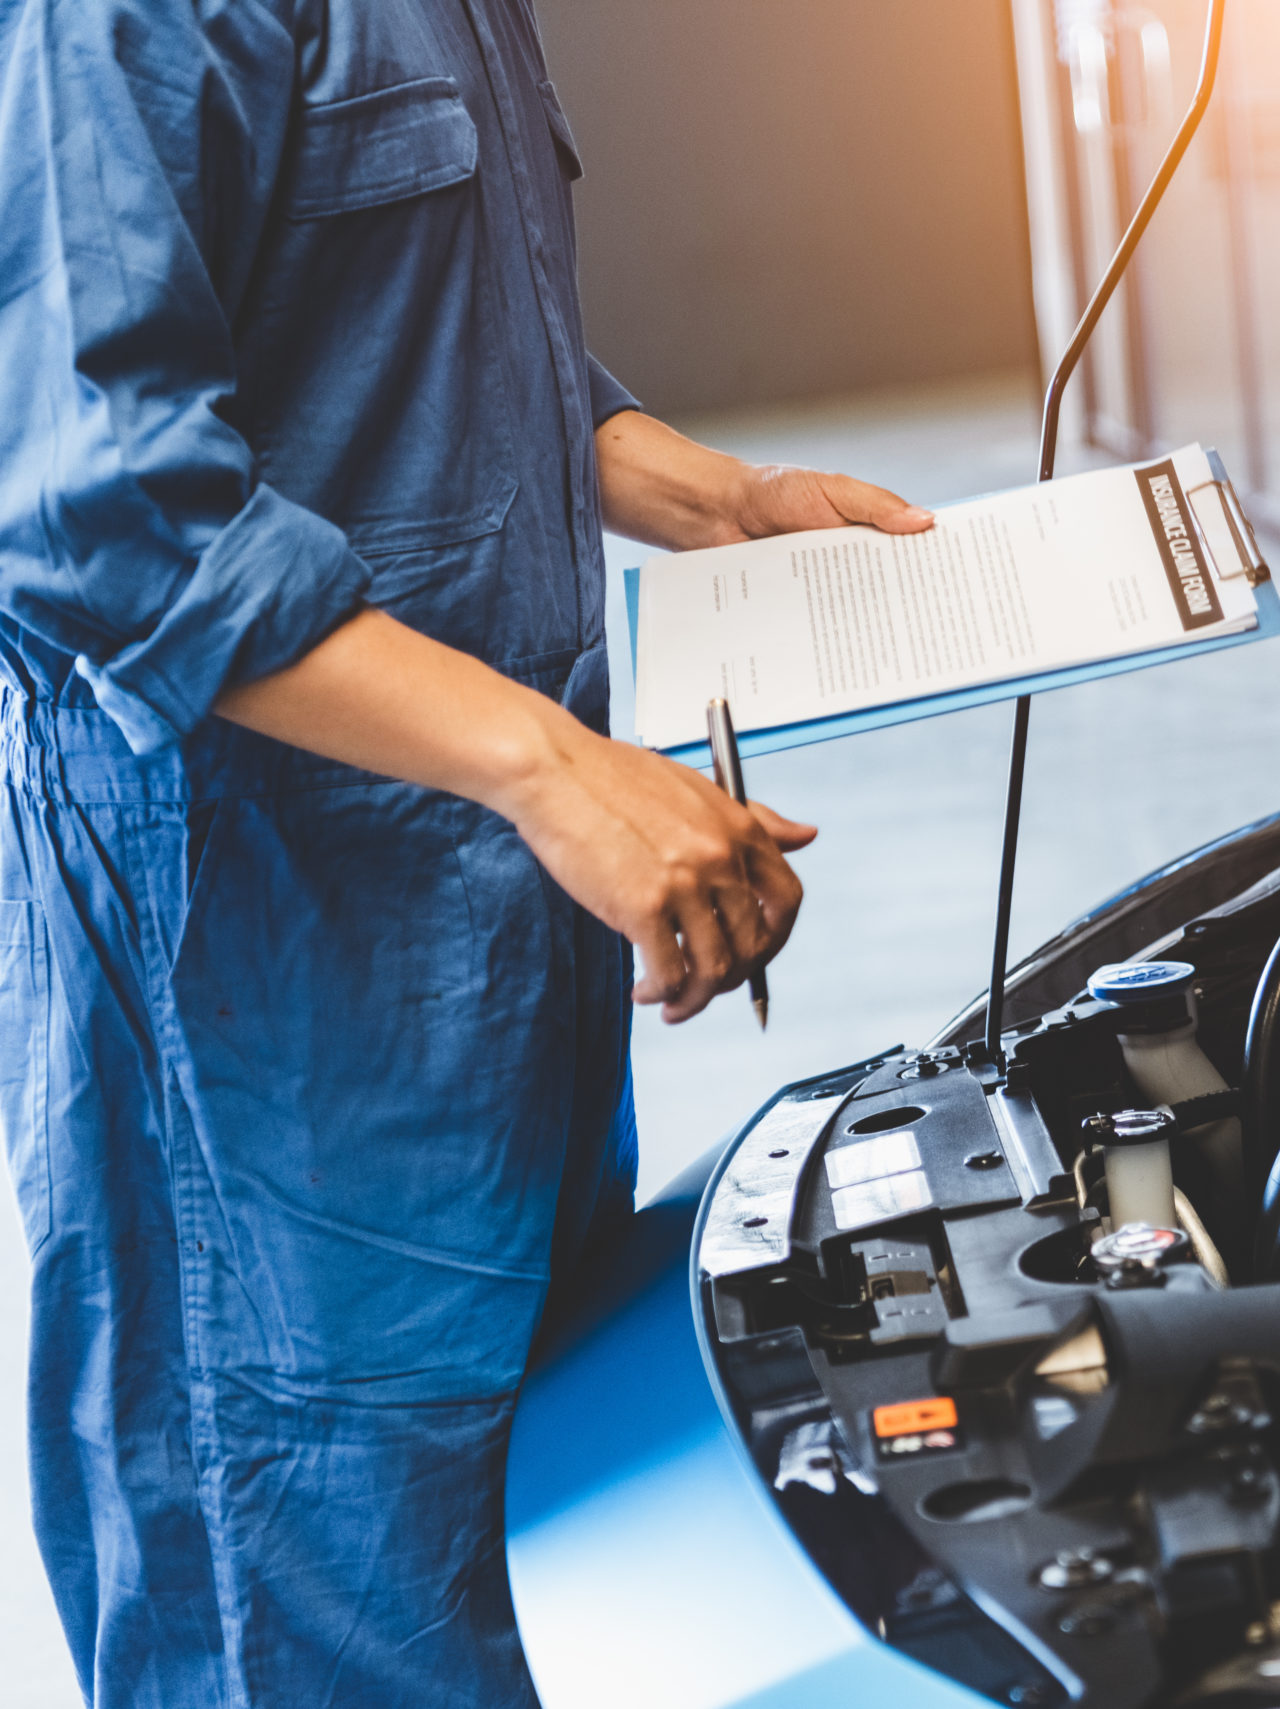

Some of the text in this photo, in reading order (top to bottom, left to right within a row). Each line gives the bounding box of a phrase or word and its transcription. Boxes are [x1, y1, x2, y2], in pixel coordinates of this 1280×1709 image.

[1148, 474, 1212, 615] INSURANCE CLAIM FORM
